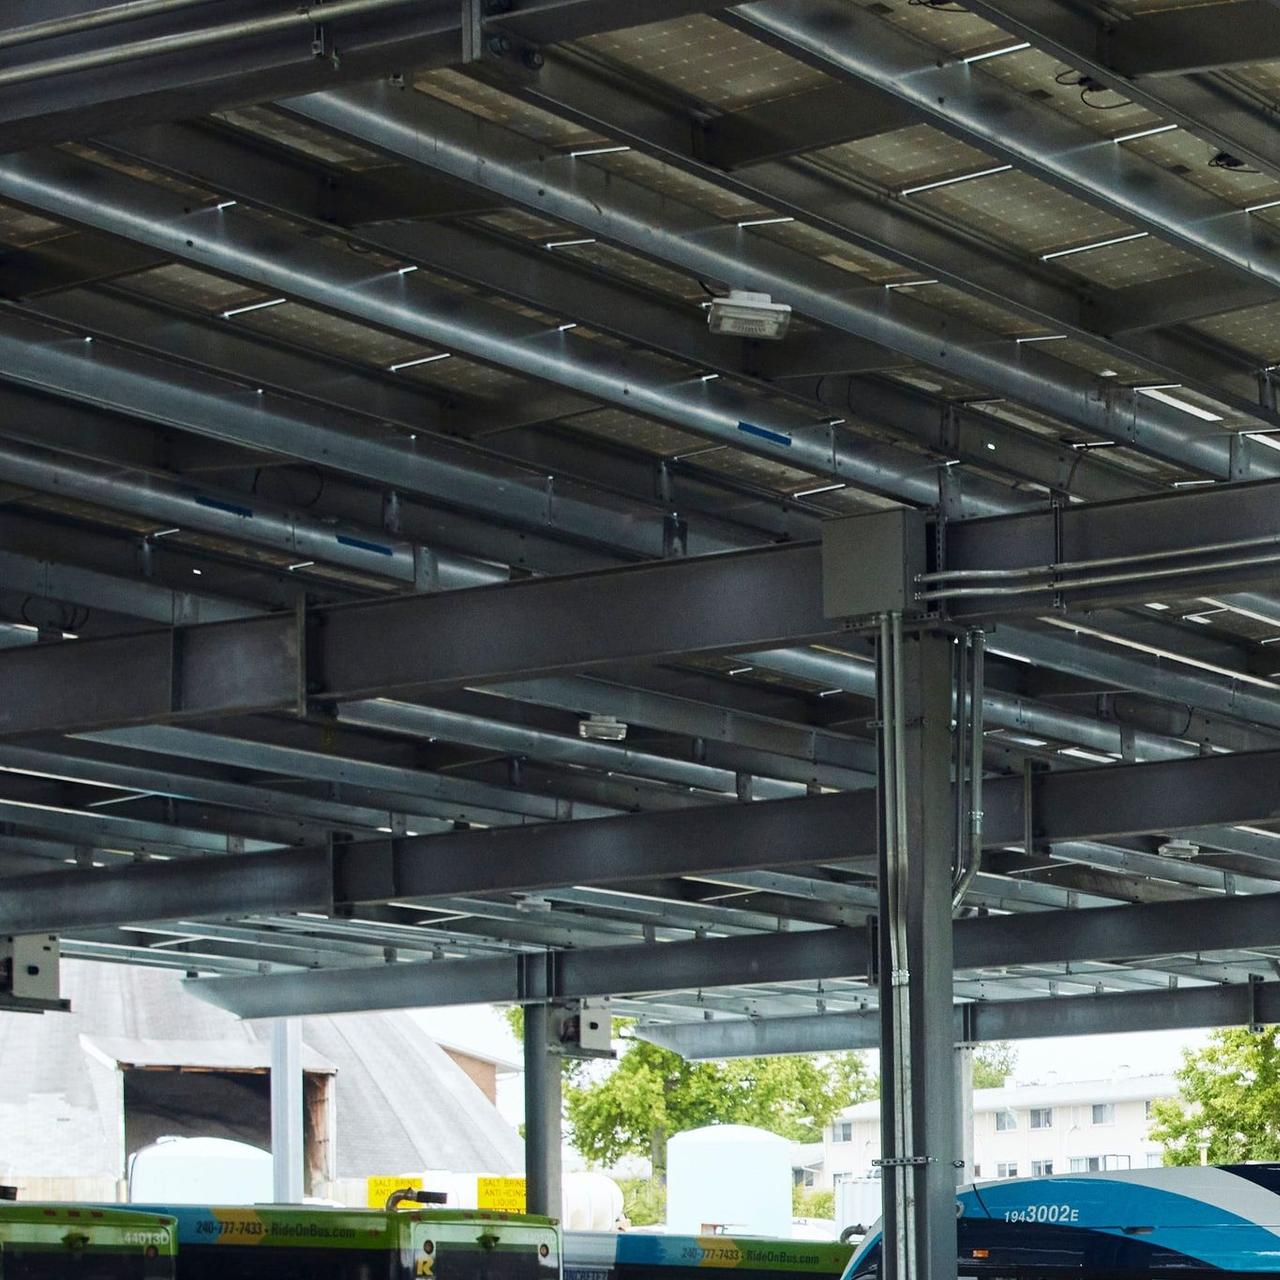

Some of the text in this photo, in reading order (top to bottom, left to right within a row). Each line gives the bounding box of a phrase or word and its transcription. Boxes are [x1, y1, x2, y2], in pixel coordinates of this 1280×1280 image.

[196, 1220, 355, 1238] 240-777-7433 RideOnBus.com
[746, 1249, 820, 1264] RideOnBus.com
